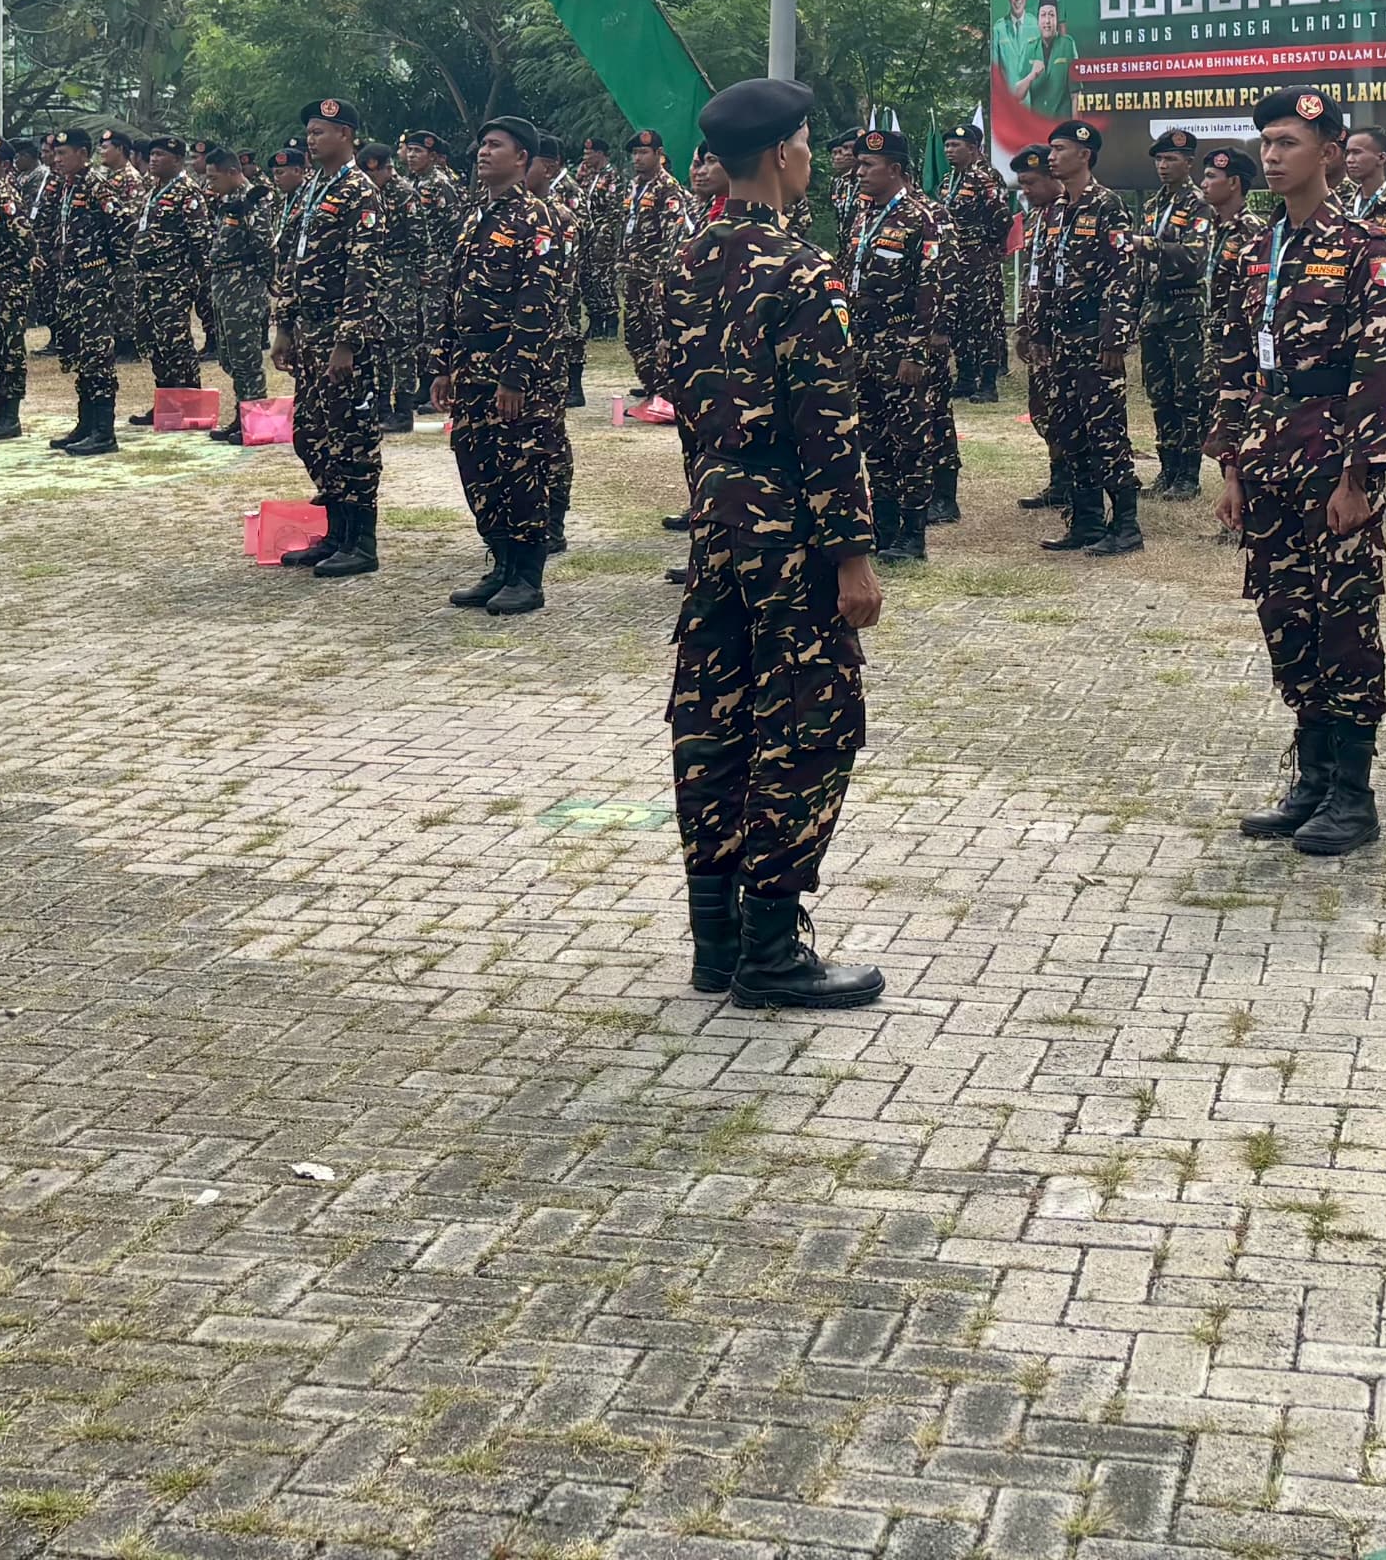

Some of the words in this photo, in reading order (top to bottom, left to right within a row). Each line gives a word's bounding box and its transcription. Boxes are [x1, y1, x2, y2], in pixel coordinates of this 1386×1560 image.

[1191, 19, 1270, 39] BANSER
[1121, 60, 1163, 72] SINERGI
[1166, 58, 1203, 69] DALAM
[1206, 55, 1269, 68] BHINNEKA,
[1272, 51, 1325, 64] BERSATU
[1329, 48, 1373, 61] DALAM
[1077, 92, 1111, 112] APEL
[1115, 91, 1161, 110] GELAR
[1164, 88, 1235, 109] PASUKAN
[1239, 87, 1259, 107] PC
[1306, 265, 1344, 275] BANSER
